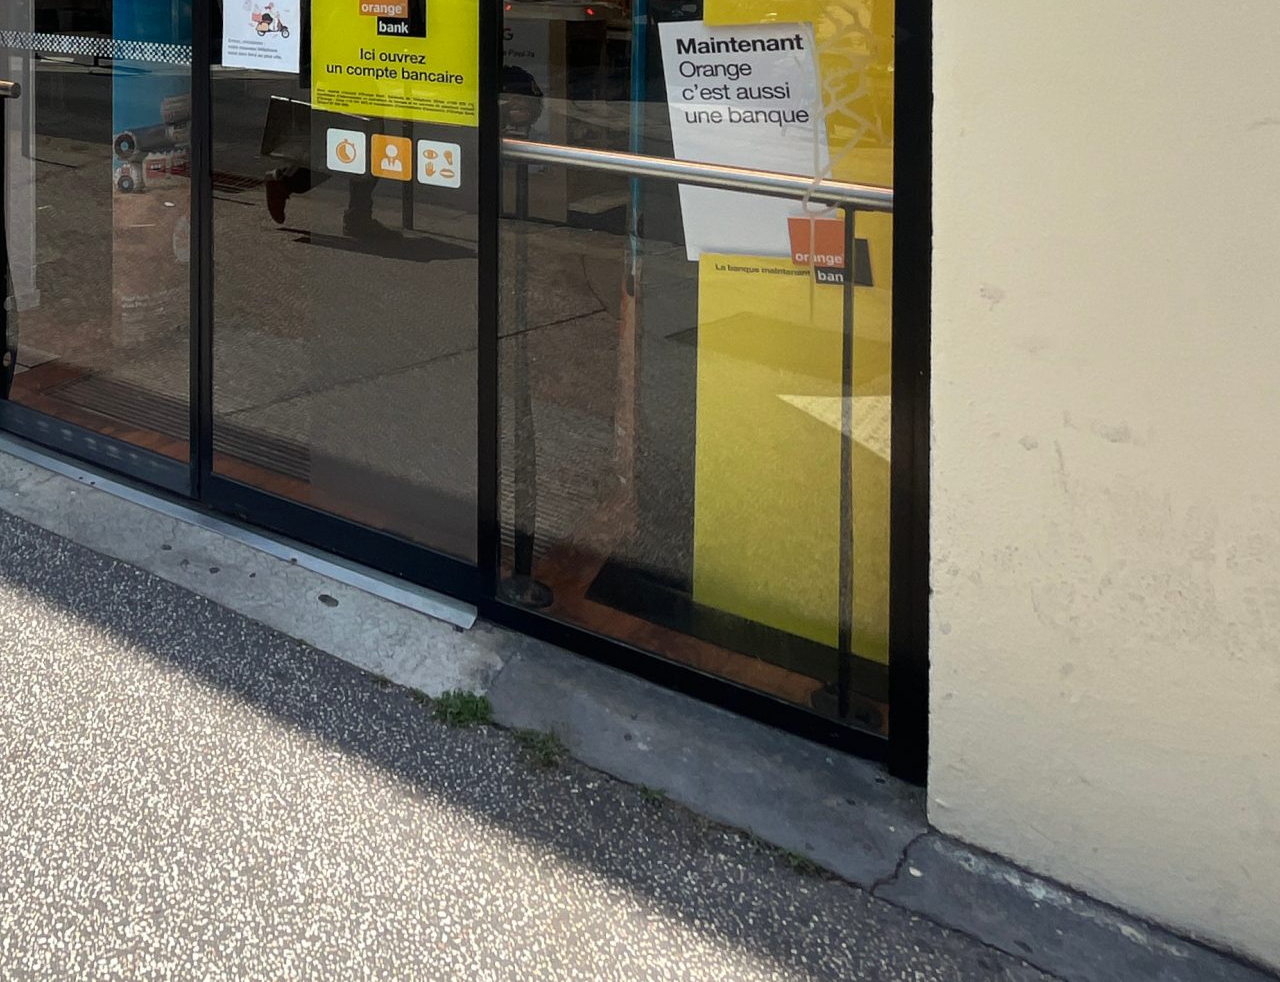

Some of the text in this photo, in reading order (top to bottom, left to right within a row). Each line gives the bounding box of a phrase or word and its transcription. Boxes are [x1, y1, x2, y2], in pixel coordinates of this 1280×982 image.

[361, 2, 402, 16] orange
[378, 20, 409, 34] bank
[675, 34, 804, 55] Maintenant
[360, 48, 426, 65] Ici ouvrez
[326, 64, 464, 84] un compte bancaire
[679, 60, 752, 81] Orange
[736, 81, 791, 100] aussi
[684, 106, 810, 127] une banque
[728, 264, 760, 274] banque
